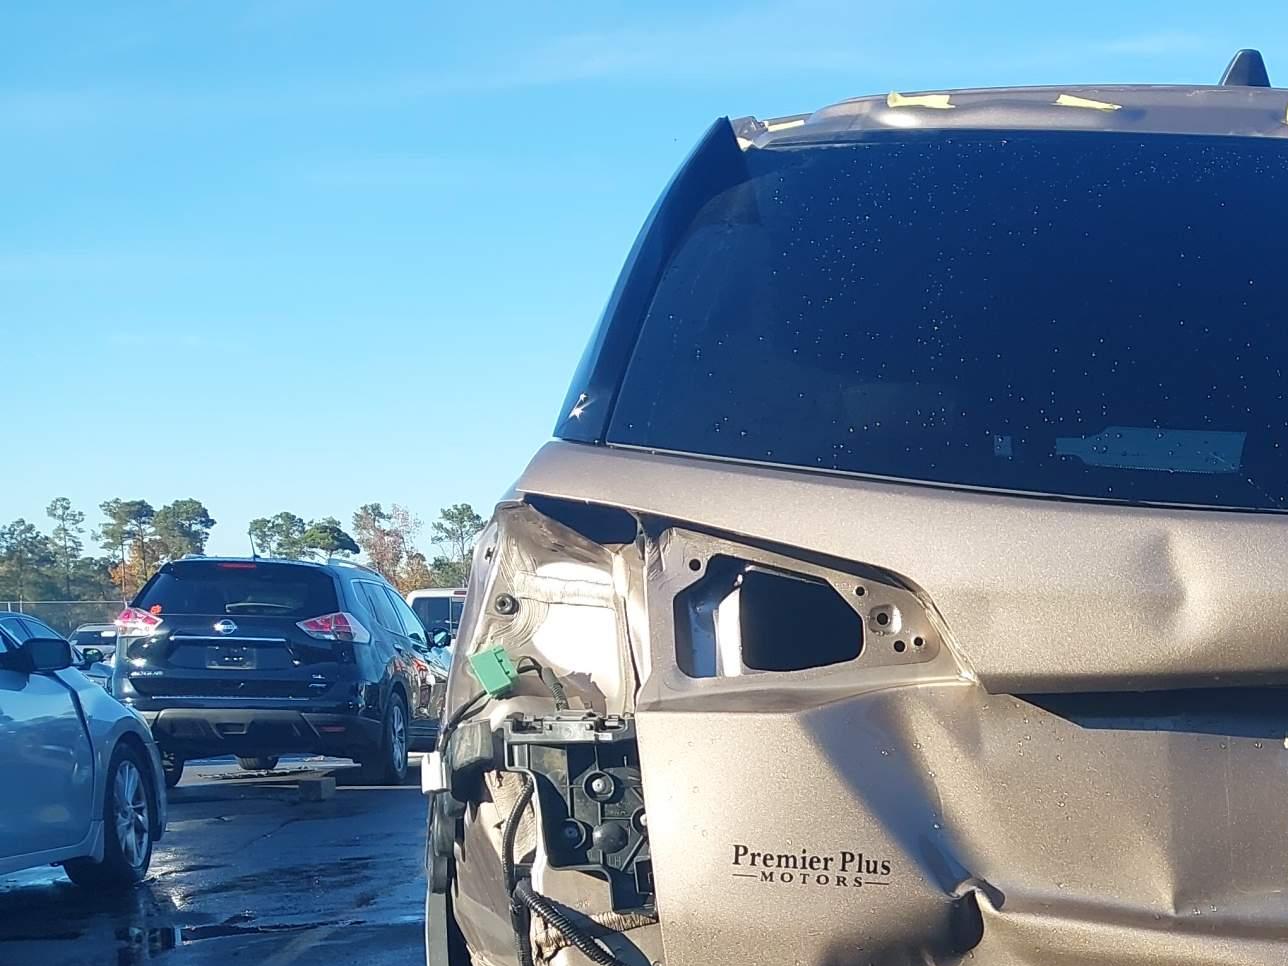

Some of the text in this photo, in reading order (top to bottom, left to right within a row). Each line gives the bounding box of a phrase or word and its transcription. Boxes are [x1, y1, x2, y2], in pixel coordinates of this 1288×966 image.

[731, 844, 892, 876] Premier Plus
[759, 870, 864, 888] MOTORS
